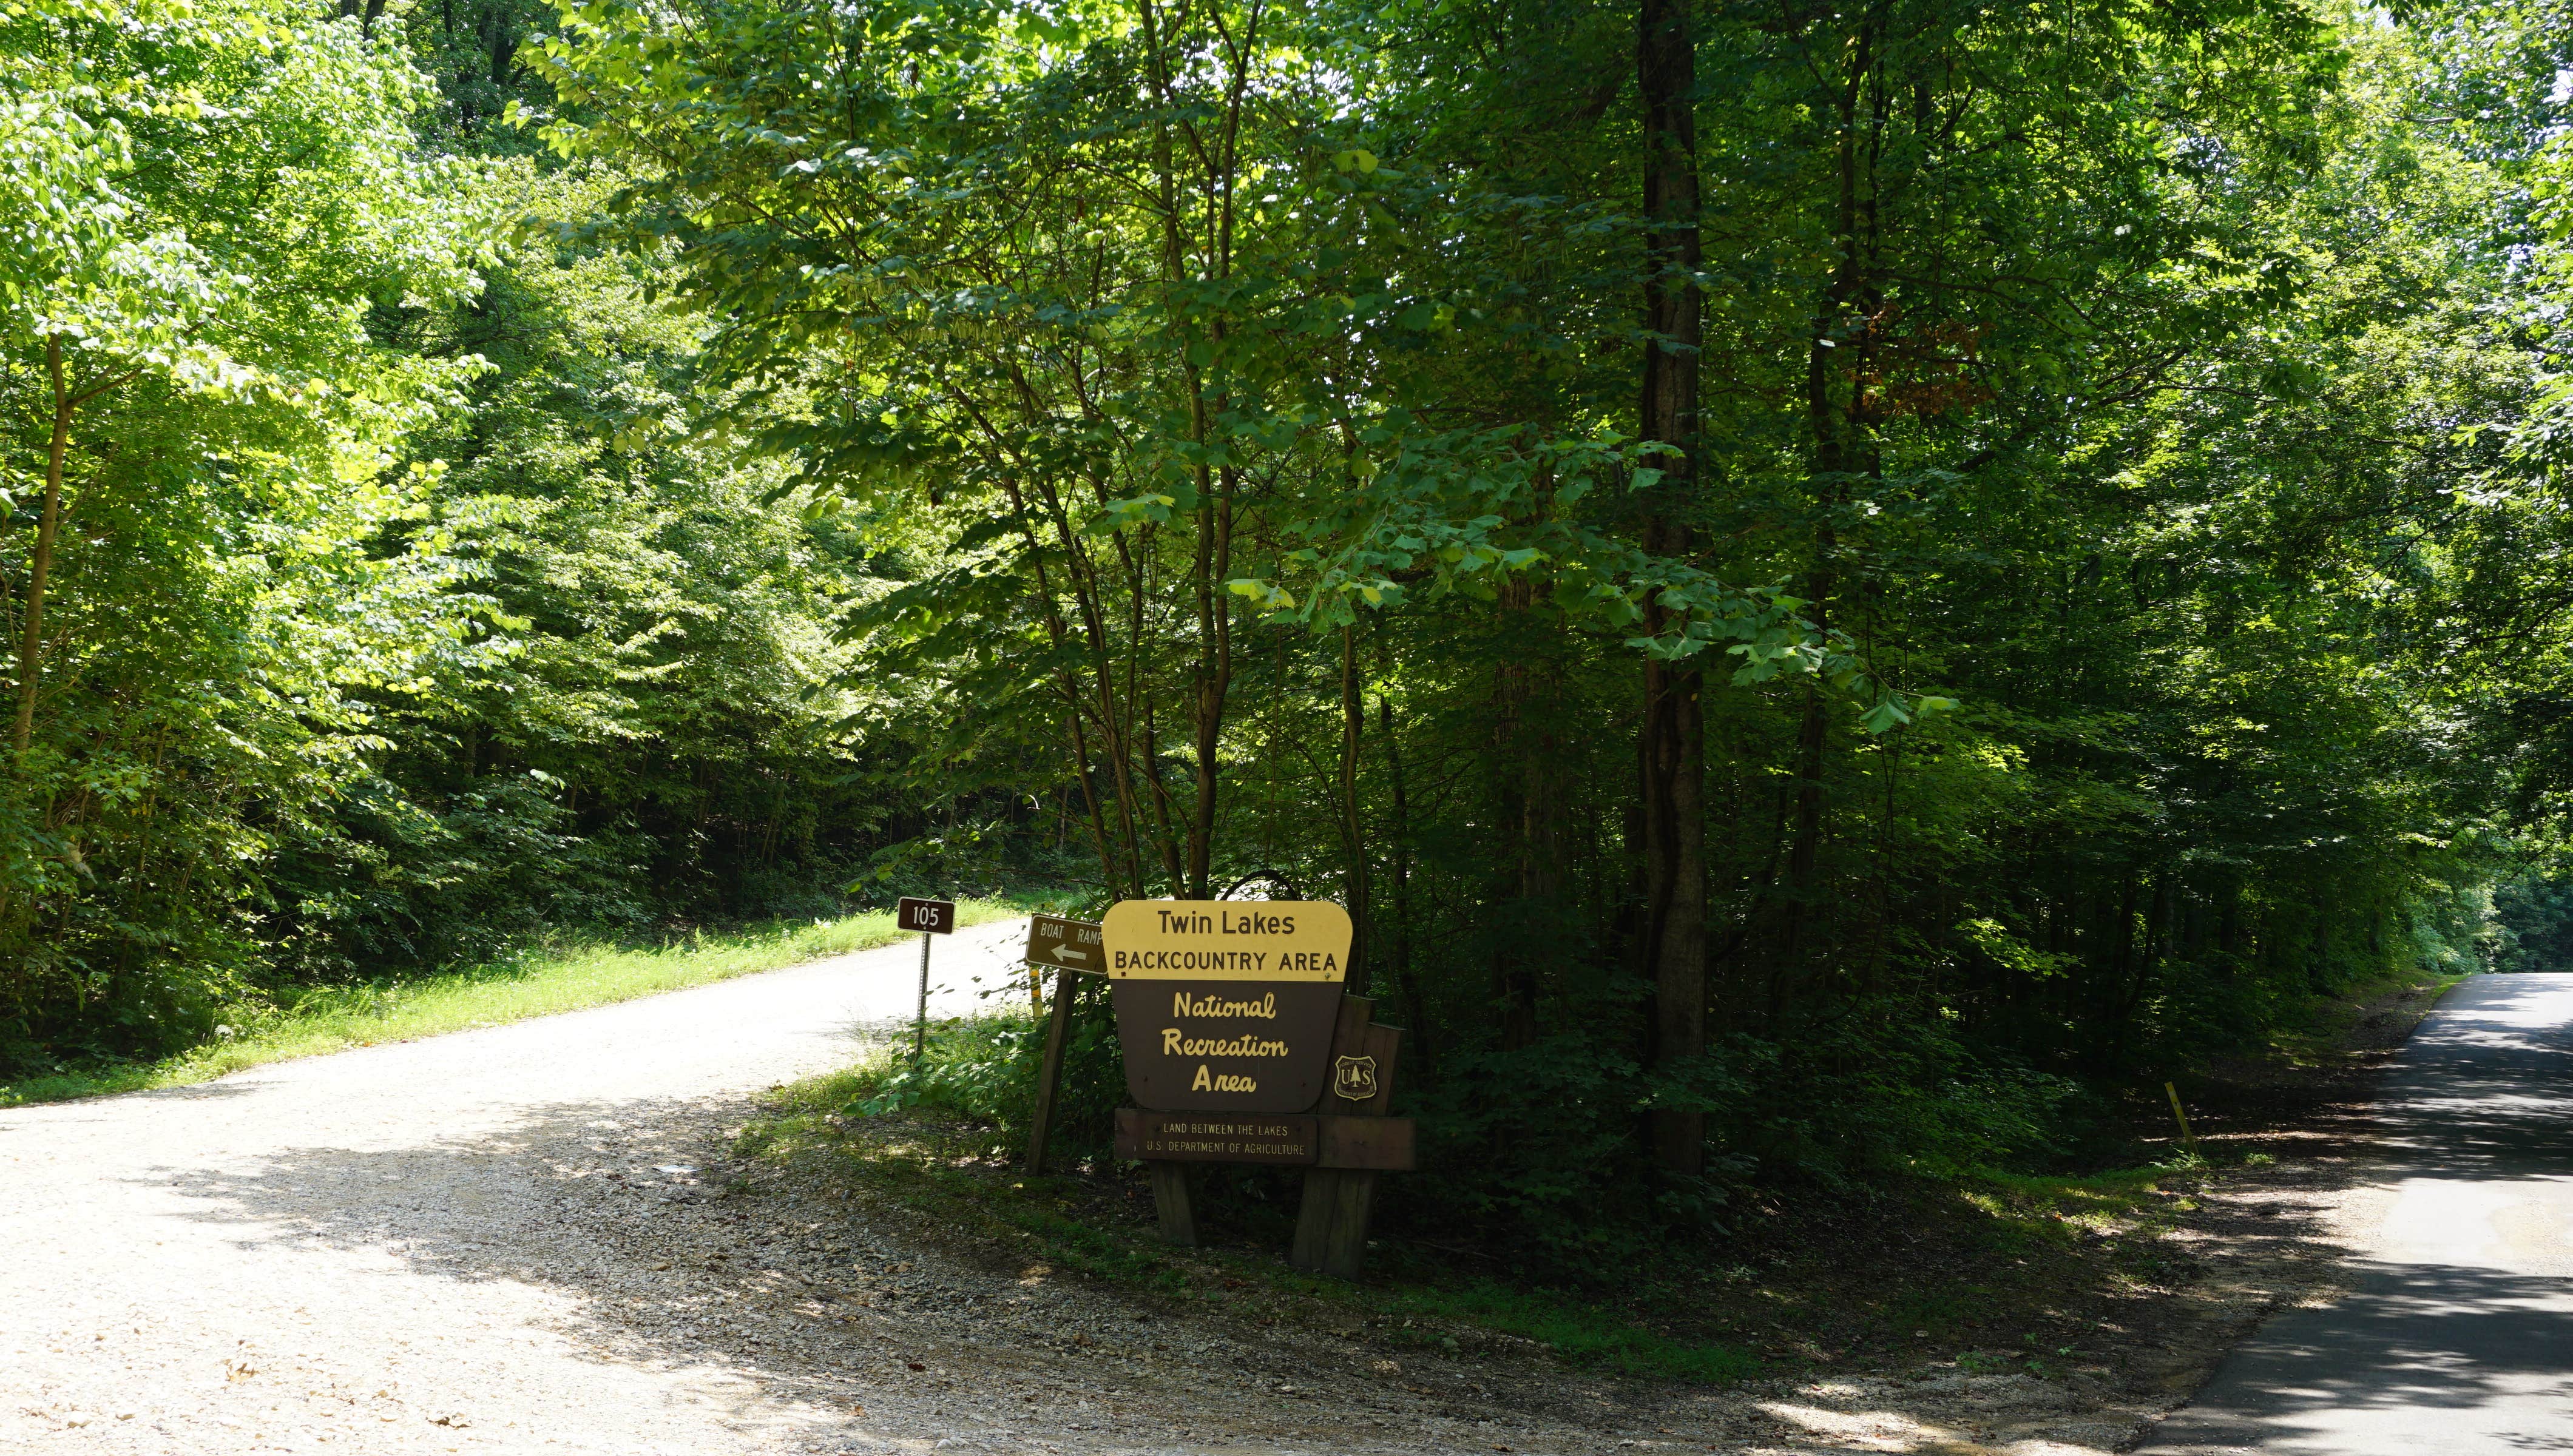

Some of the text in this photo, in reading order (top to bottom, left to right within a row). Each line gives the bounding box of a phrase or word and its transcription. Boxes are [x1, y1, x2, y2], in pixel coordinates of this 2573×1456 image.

[913, 906, 939, 926] 105
[1158, 911, 1295, 934] Twin Lakes
[1040, 923, 1103, 945] BOAT RAMP
[1115, 951, 1337, 971] BACKCOUNTRY AREA
[1174, 991, 1277, 1019] National
[1161, 1028, 1288, 1057] Recreation
[1191, 1064, 1257, 1093] Area
[1163, 1123, 1288, 1136] LAND BETWEEN THE LAKES
[1147, 1141, 1305, 1155] U.S. DEPARTMENT OF AGRICULTURE
